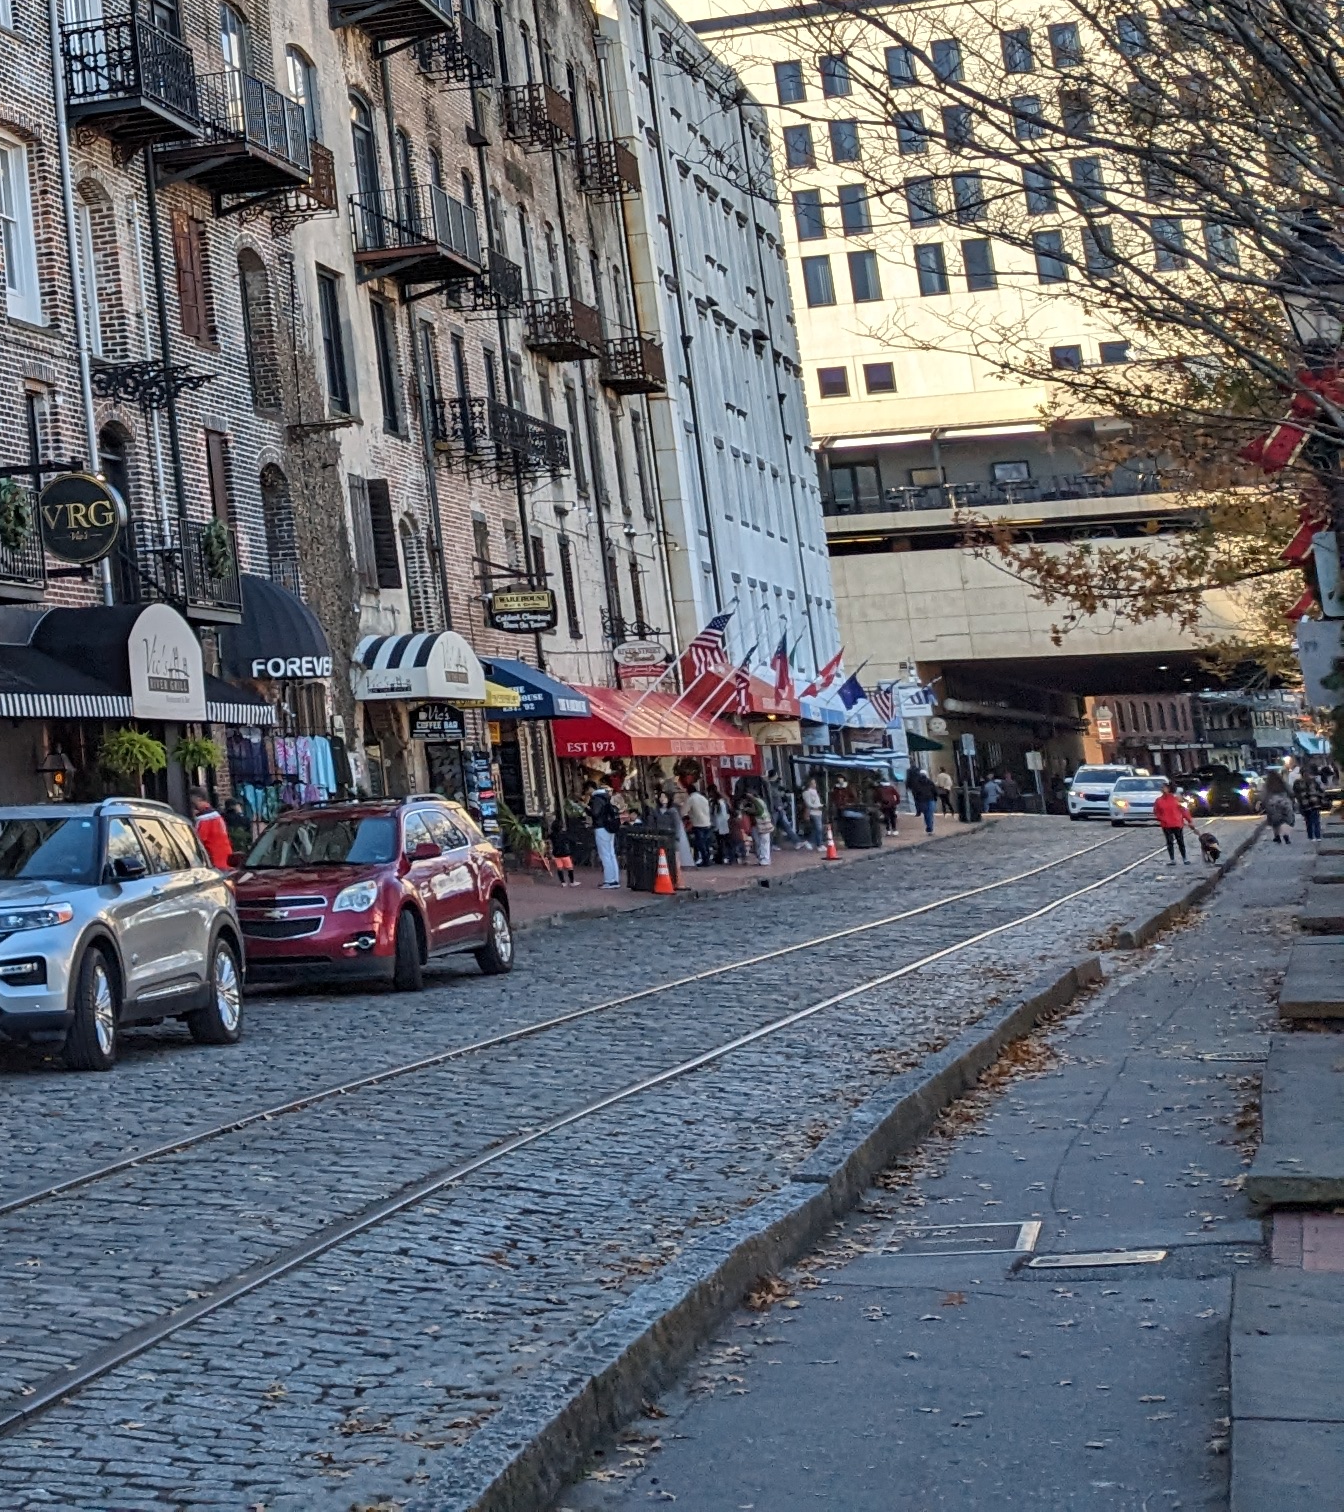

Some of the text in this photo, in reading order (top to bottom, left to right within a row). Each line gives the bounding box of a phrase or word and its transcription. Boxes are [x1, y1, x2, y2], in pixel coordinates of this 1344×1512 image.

[41, 500, 115, 530] VRG
[416, 721, 459, 729] COFFEE BAR
[567, 741, 616, 753] EST 1973
